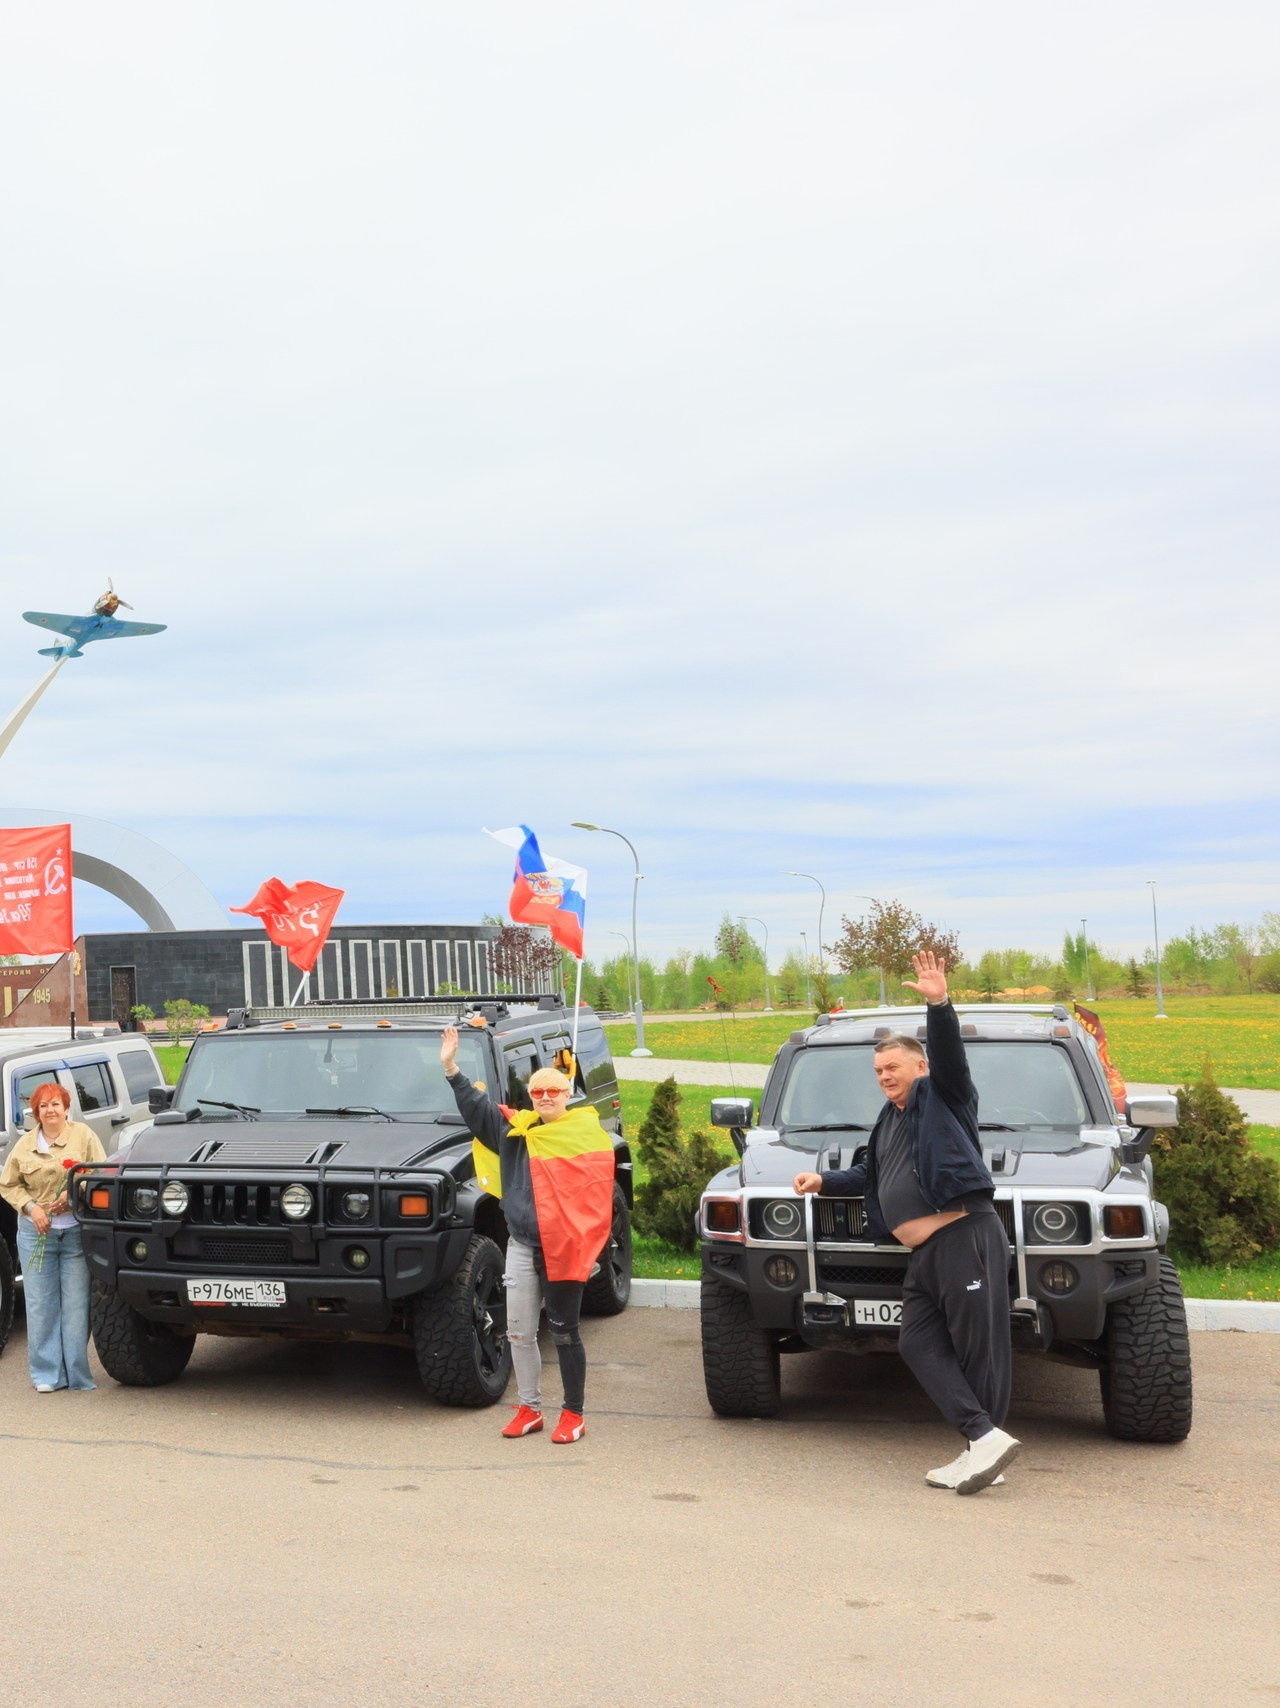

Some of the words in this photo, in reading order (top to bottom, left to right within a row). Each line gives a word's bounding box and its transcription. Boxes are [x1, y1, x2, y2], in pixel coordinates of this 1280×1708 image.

[33, 988, 51, 1005] 1945
[204, 1198, 279, 1207] UMME
[864, 1304, 903, 1323] Н02
